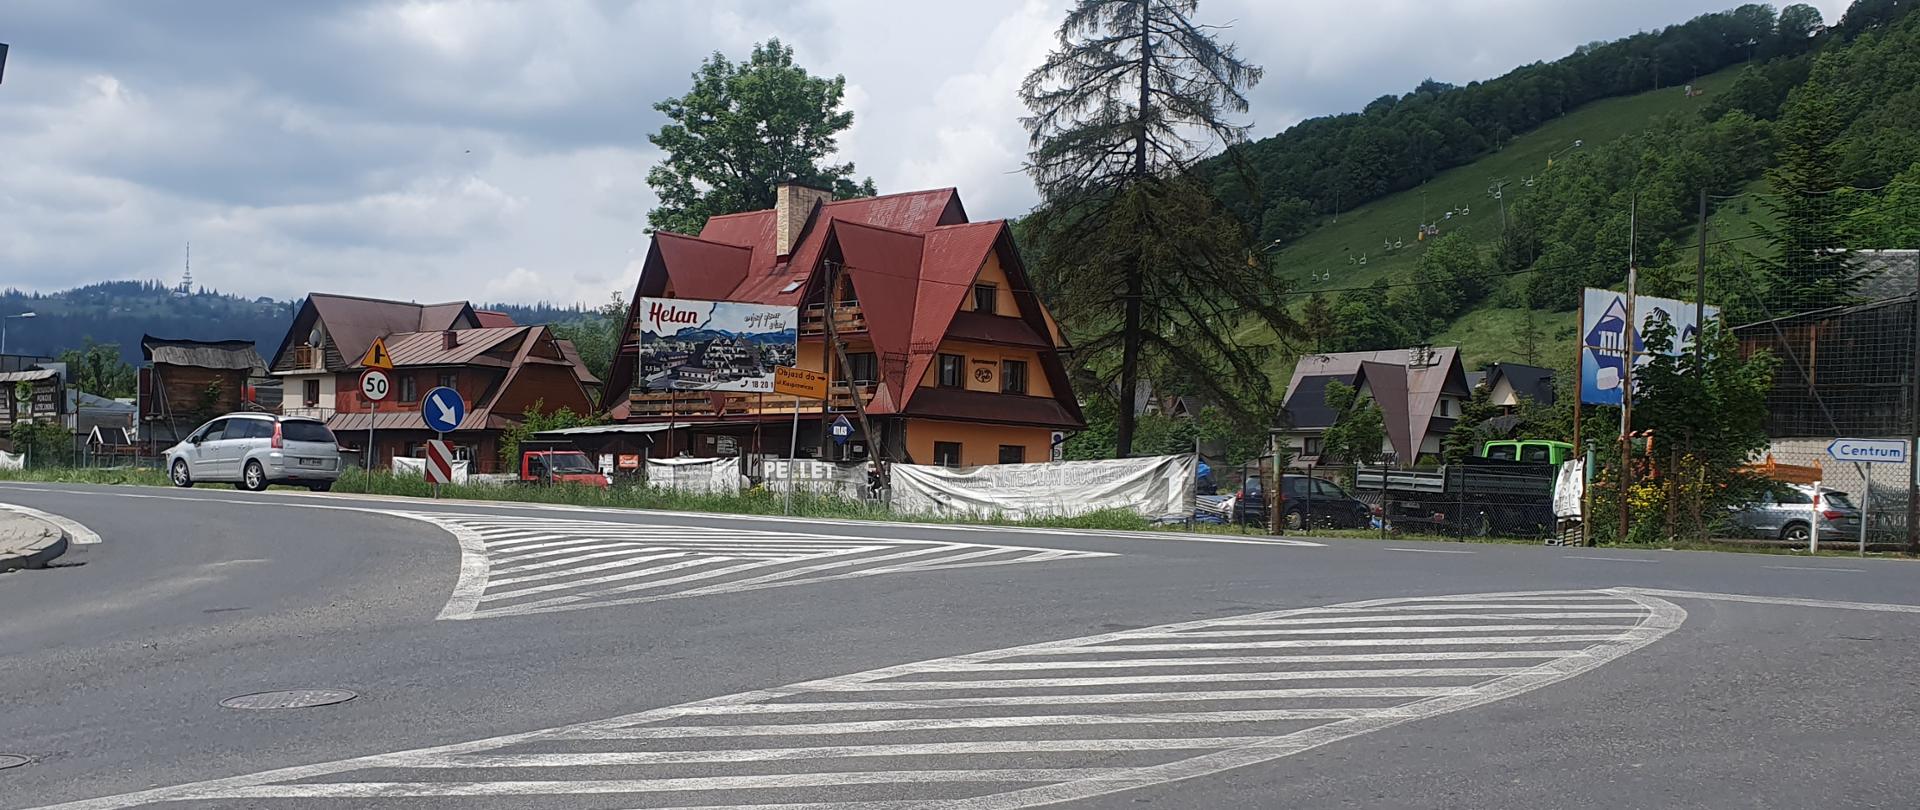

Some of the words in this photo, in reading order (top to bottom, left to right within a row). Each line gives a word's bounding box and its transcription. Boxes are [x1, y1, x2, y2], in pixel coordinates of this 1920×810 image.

[649, 301, 698, 333] Helan
[777, 367, 804, 380] Objazd
[805, 372, 816, 381] do
[366, 377, 387, 394] 50
[1840, 444, 1901, 457] Centrum
